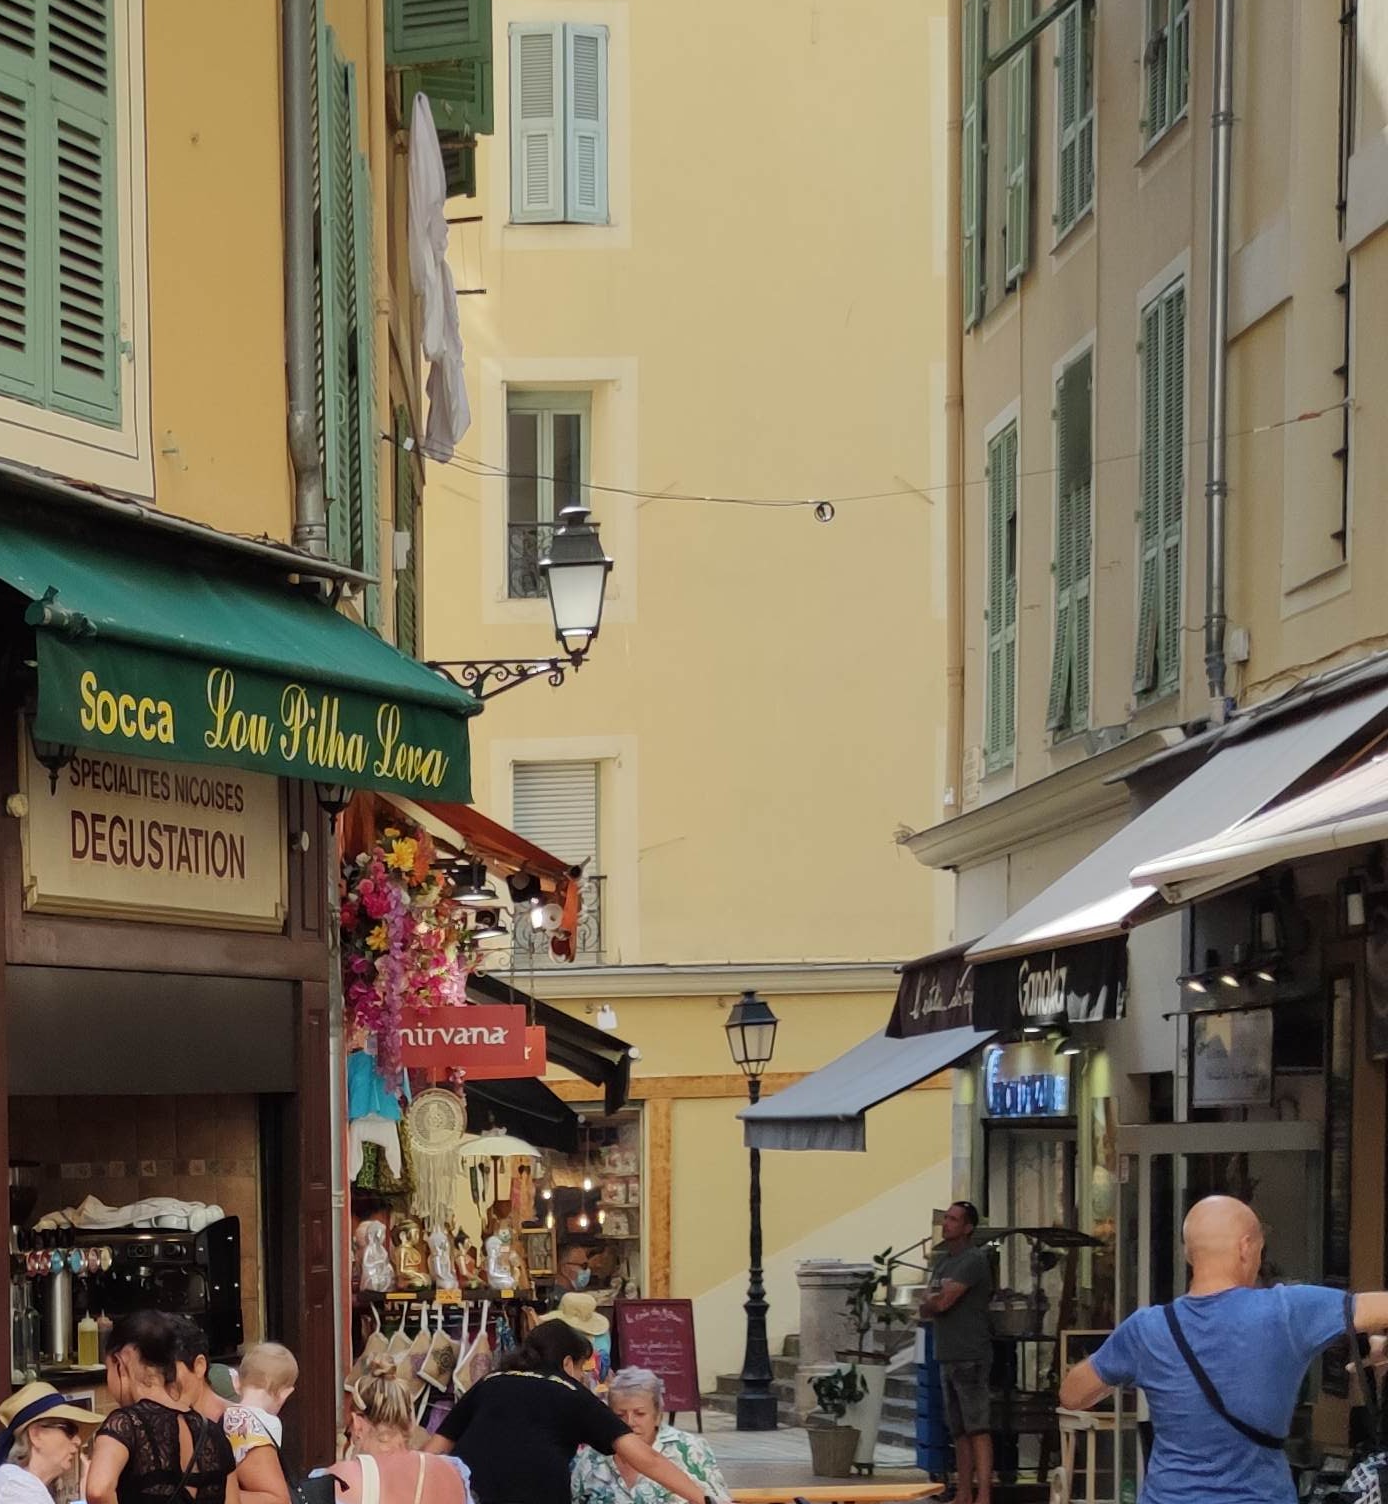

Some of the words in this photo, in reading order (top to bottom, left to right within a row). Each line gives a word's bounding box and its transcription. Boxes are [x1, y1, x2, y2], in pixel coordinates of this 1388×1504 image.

[80, 670, 175, 745] Socca
[204, 667, 275, 757] Lou
[279, 684, 370, 774] Pilha
[373, 703, 449, 789] Leva
[69, 758, 171, 802] SPECIALITES
[70, 810, 246, 880] DEGUSTATION
[399, 1022, 508, 1046] nirvana
